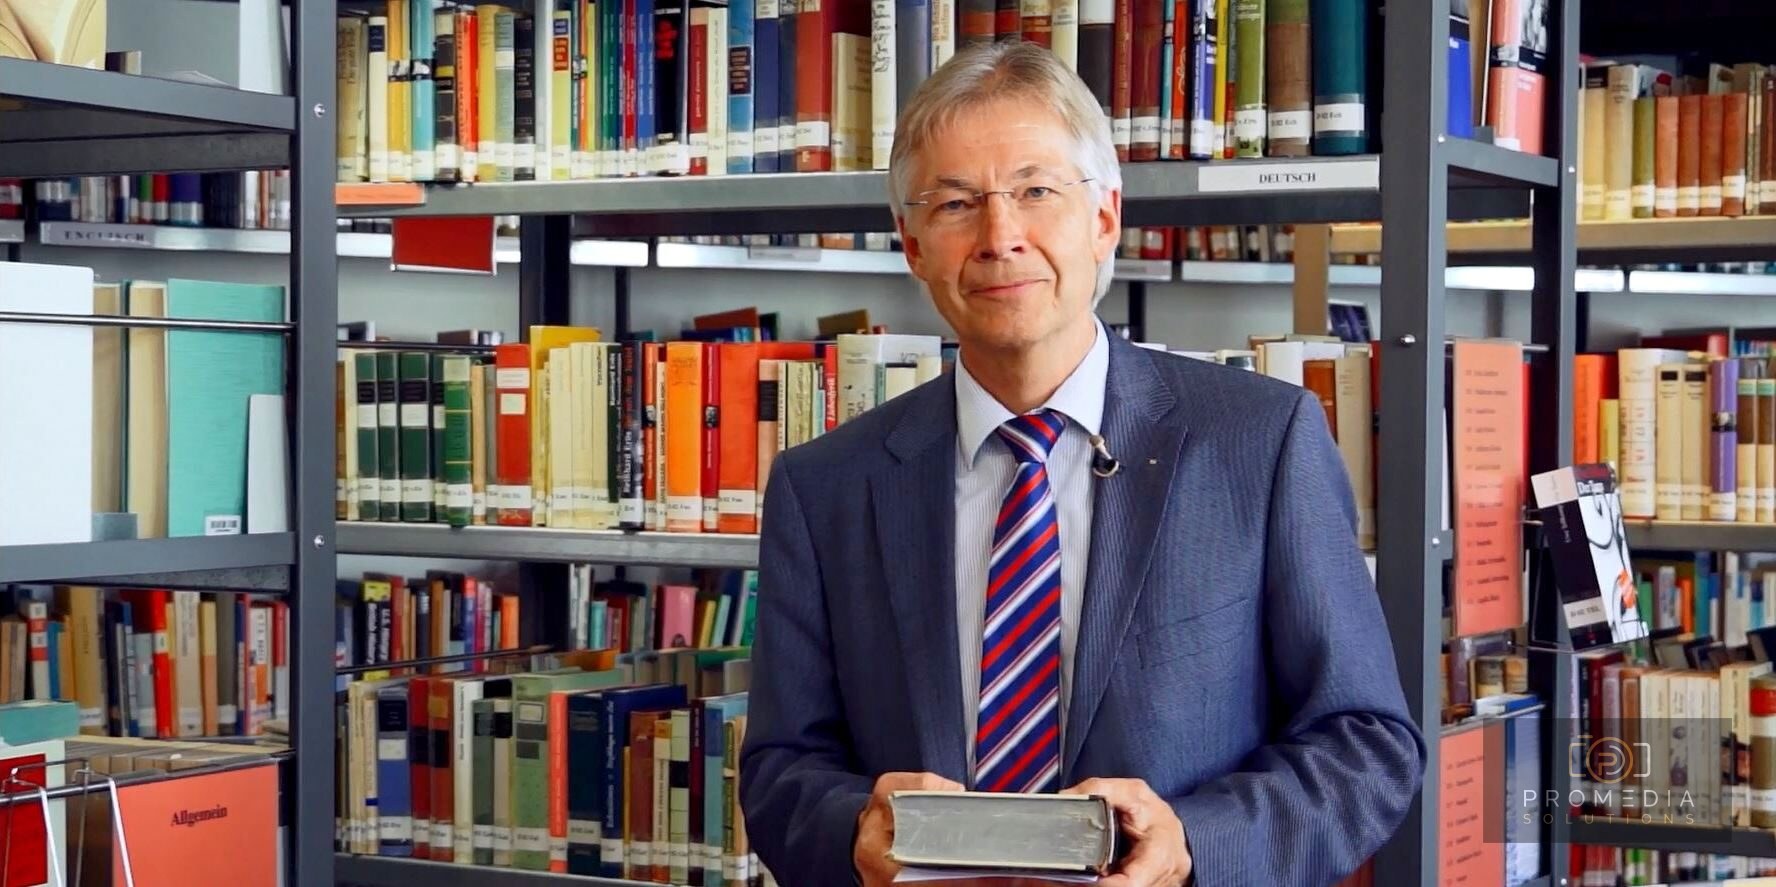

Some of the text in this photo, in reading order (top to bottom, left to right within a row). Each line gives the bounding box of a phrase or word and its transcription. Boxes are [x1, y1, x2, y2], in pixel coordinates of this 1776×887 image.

[1258, 172, 1317, 184] DEUTSCH
[63, 230, 146, 243] ENGLISCH
[170, 803, 228, 827] Allgemein
